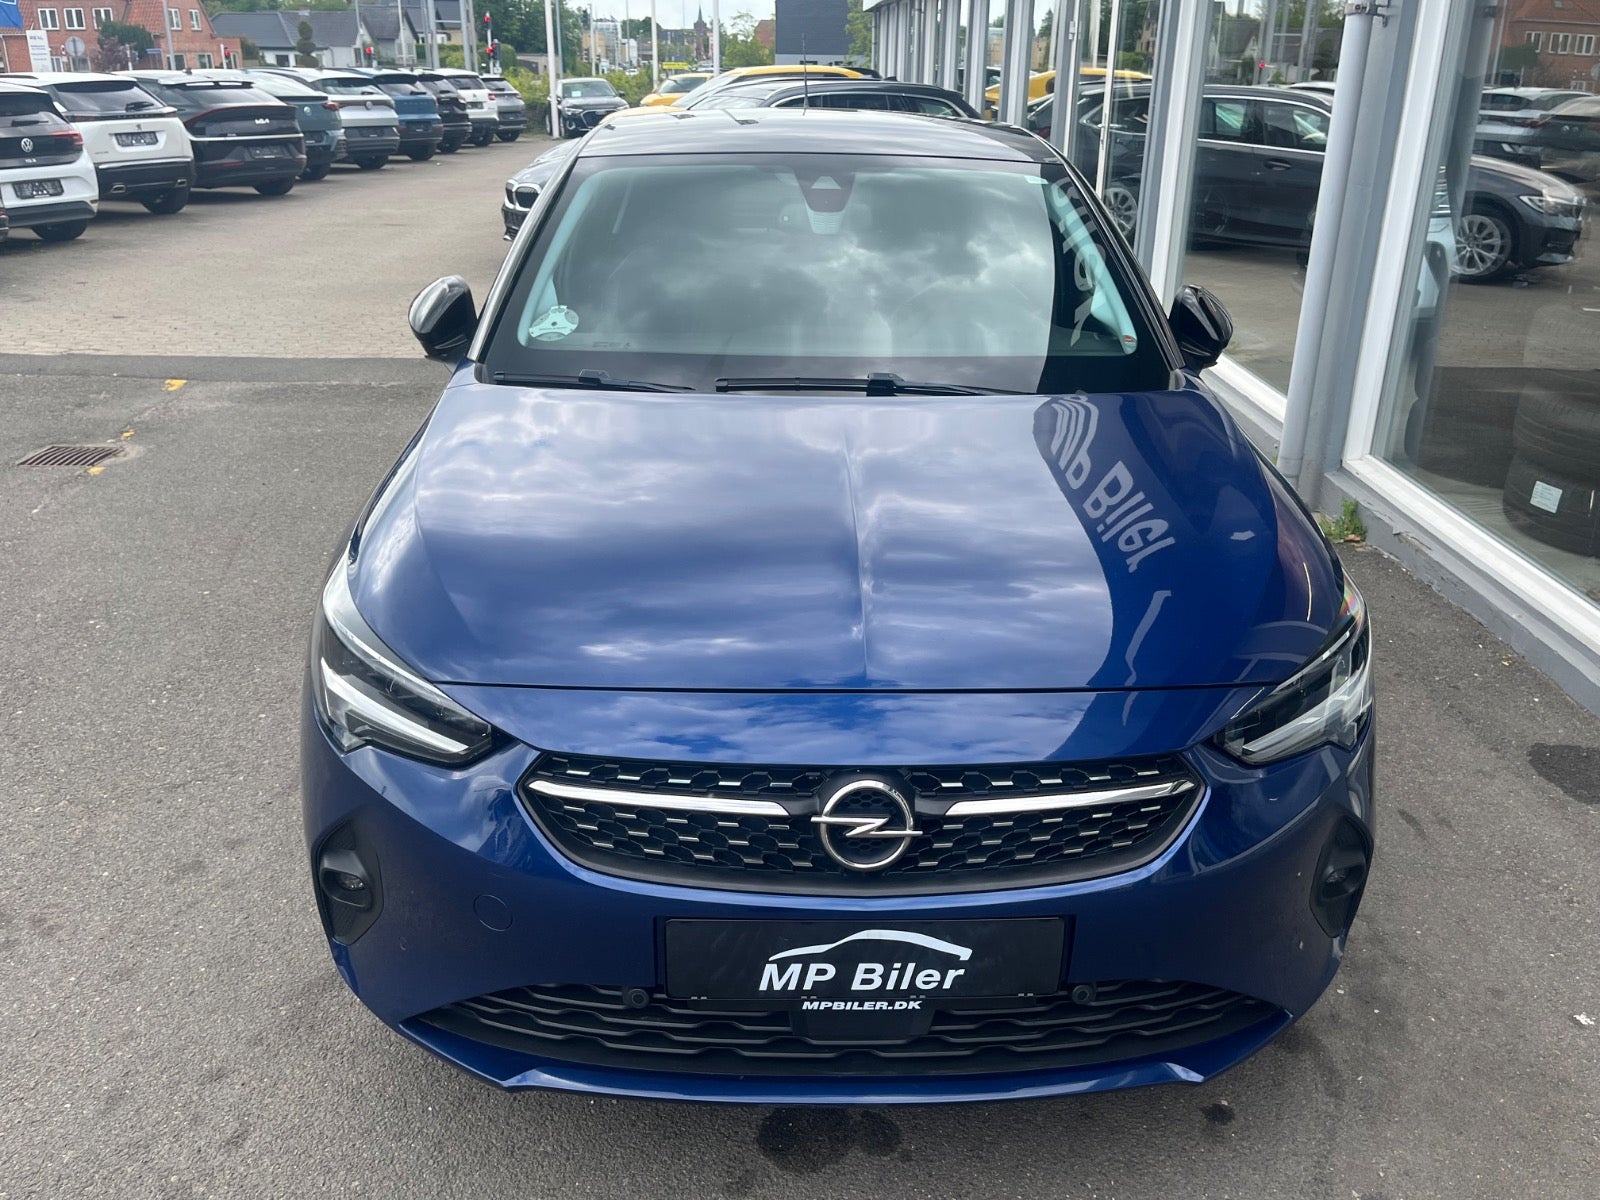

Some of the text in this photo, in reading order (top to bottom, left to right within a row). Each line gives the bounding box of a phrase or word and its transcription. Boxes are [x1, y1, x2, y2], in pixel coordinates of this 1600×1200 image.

[758, 962, 966, 992] MP Biler
[801, 1000, 923, 1011] MPBILER.DK
